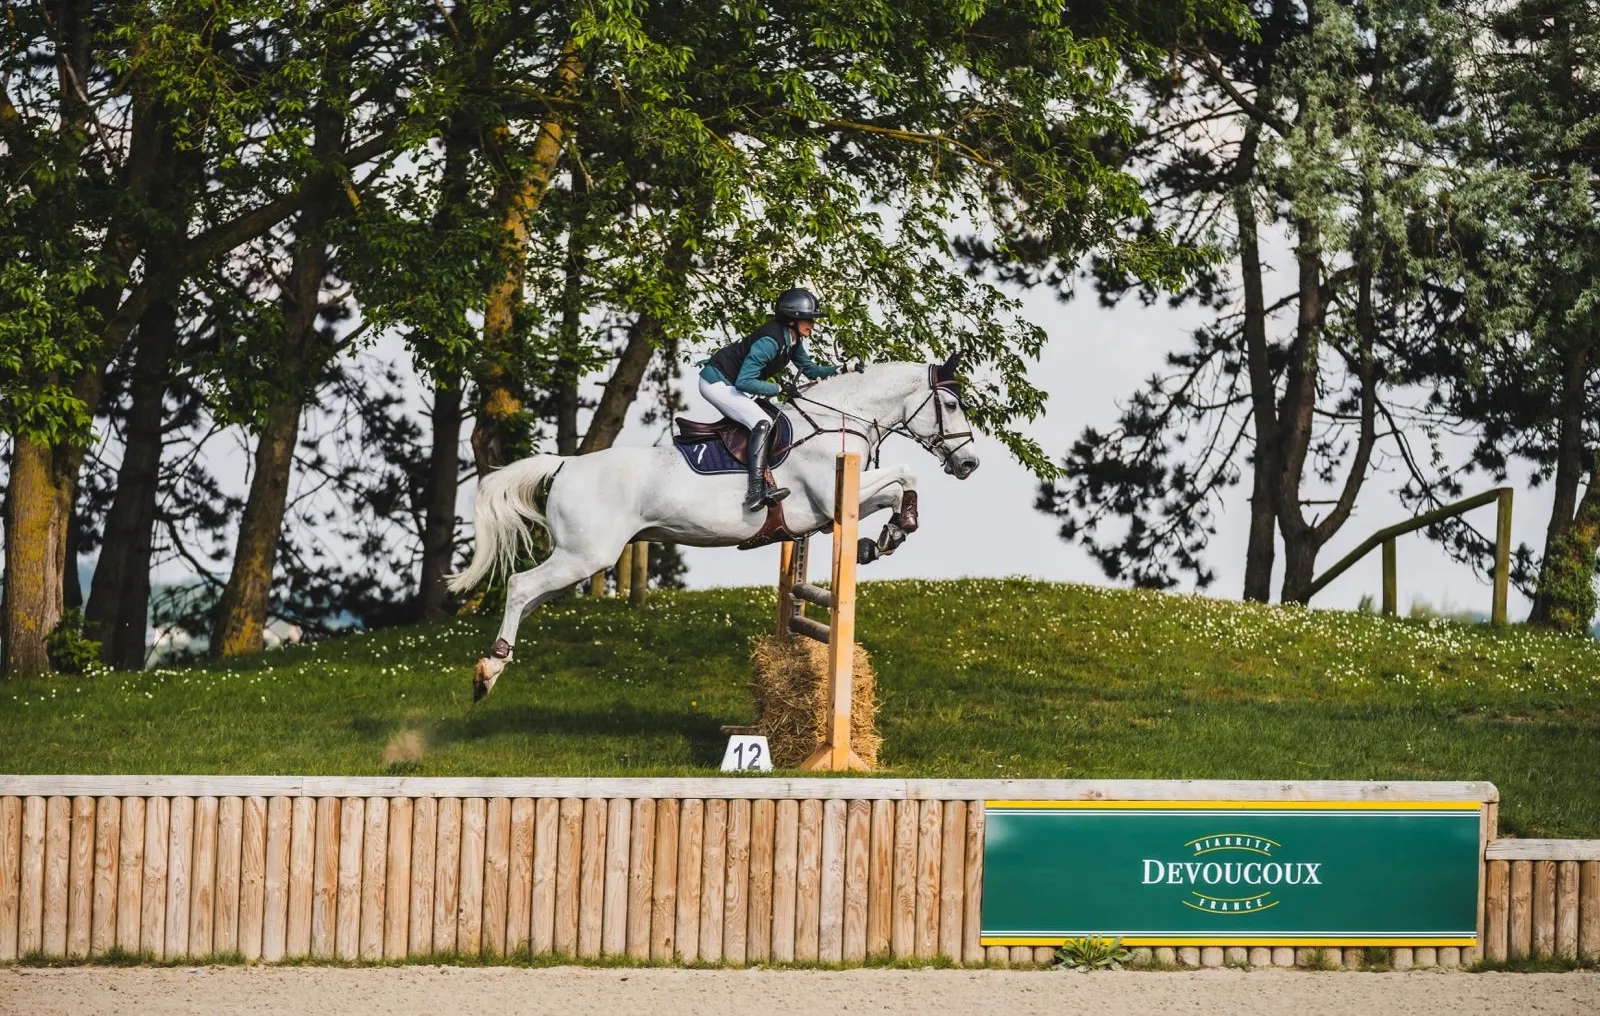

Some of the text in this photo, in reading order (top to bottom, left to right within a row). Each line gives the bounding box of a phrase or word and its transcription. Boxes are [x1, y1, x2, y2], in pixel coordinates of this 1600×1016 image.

[733, 742, 762, 770] 12
[1195, 837, 1272, 851] BIARRITZ
[1141, 859, 1322, 884] DEVOUCOUX
[1199, 898, 1263, 911] FRANCE
